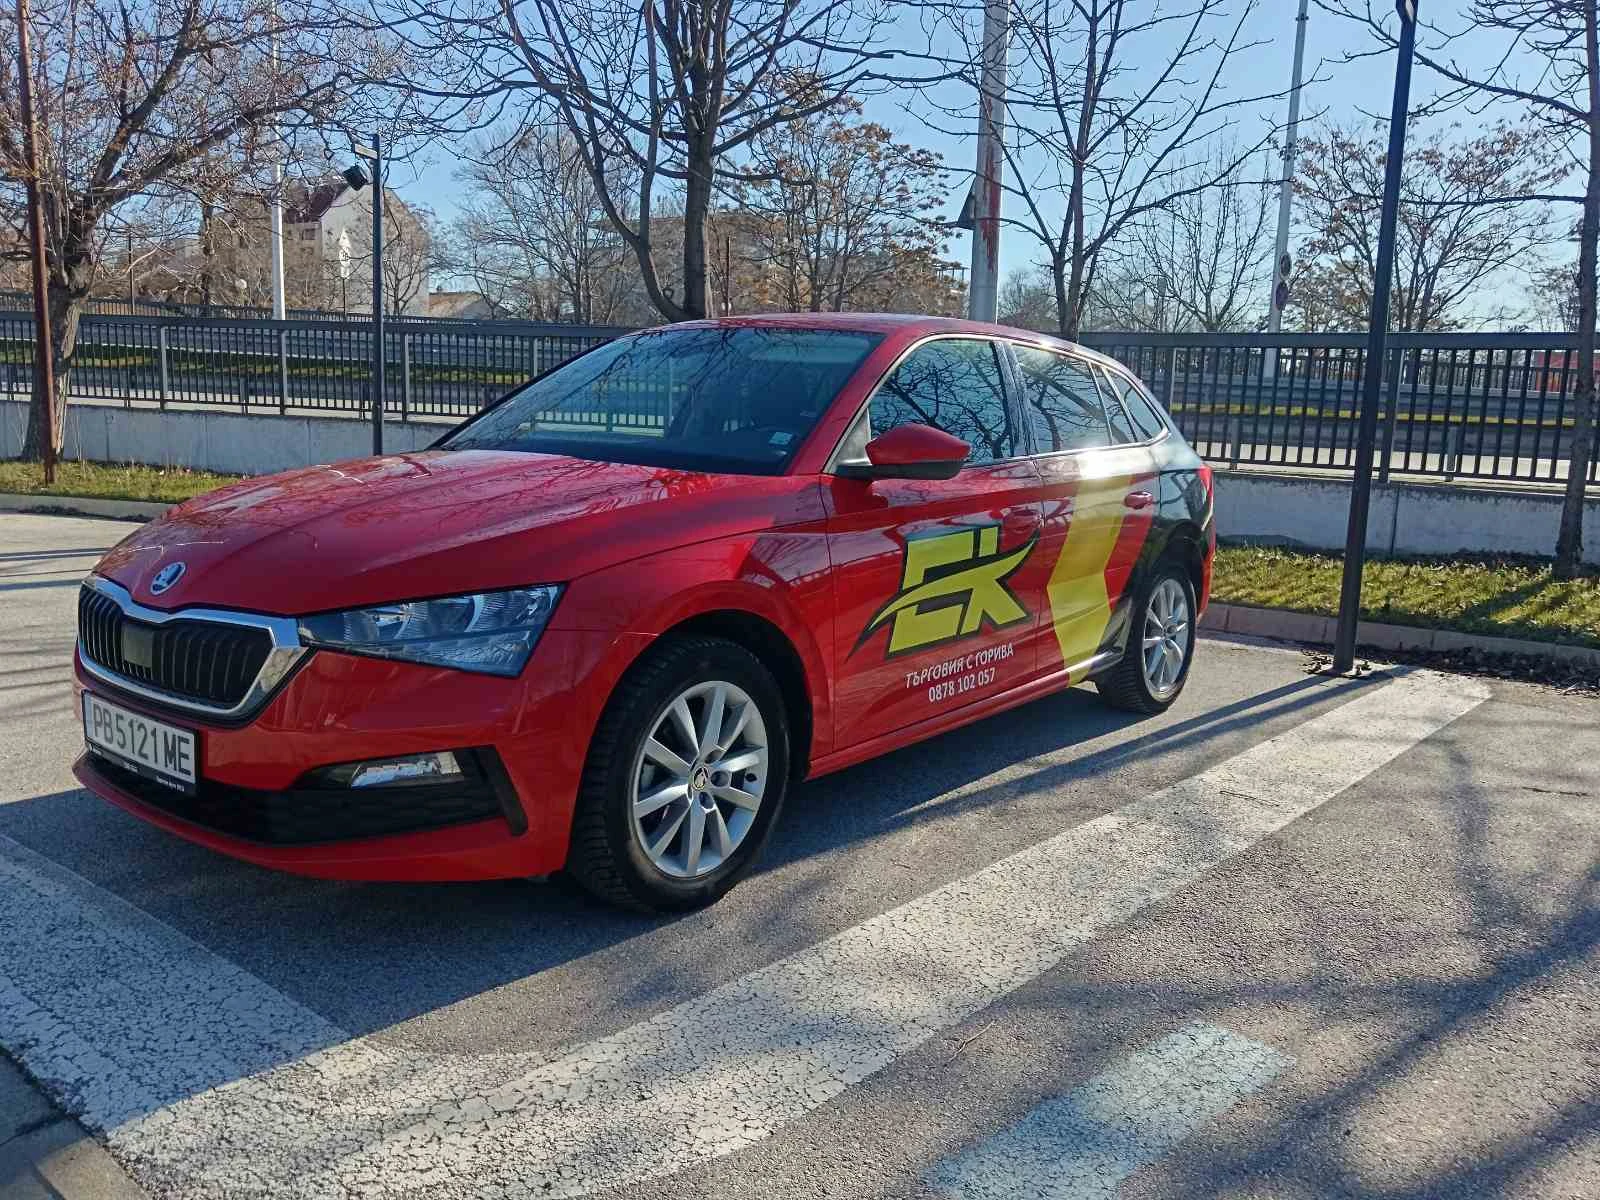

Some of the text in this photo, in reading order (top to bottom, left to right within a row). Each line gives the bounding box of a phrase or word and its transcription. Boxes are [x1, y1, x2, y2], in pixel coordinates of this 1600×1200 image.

[905, 657, 964, 688] ТЪРГОВИЯ
[975, 642, 1014, 667] ГОРИВА
[928, 667, 996, 702] 0878 102 057
